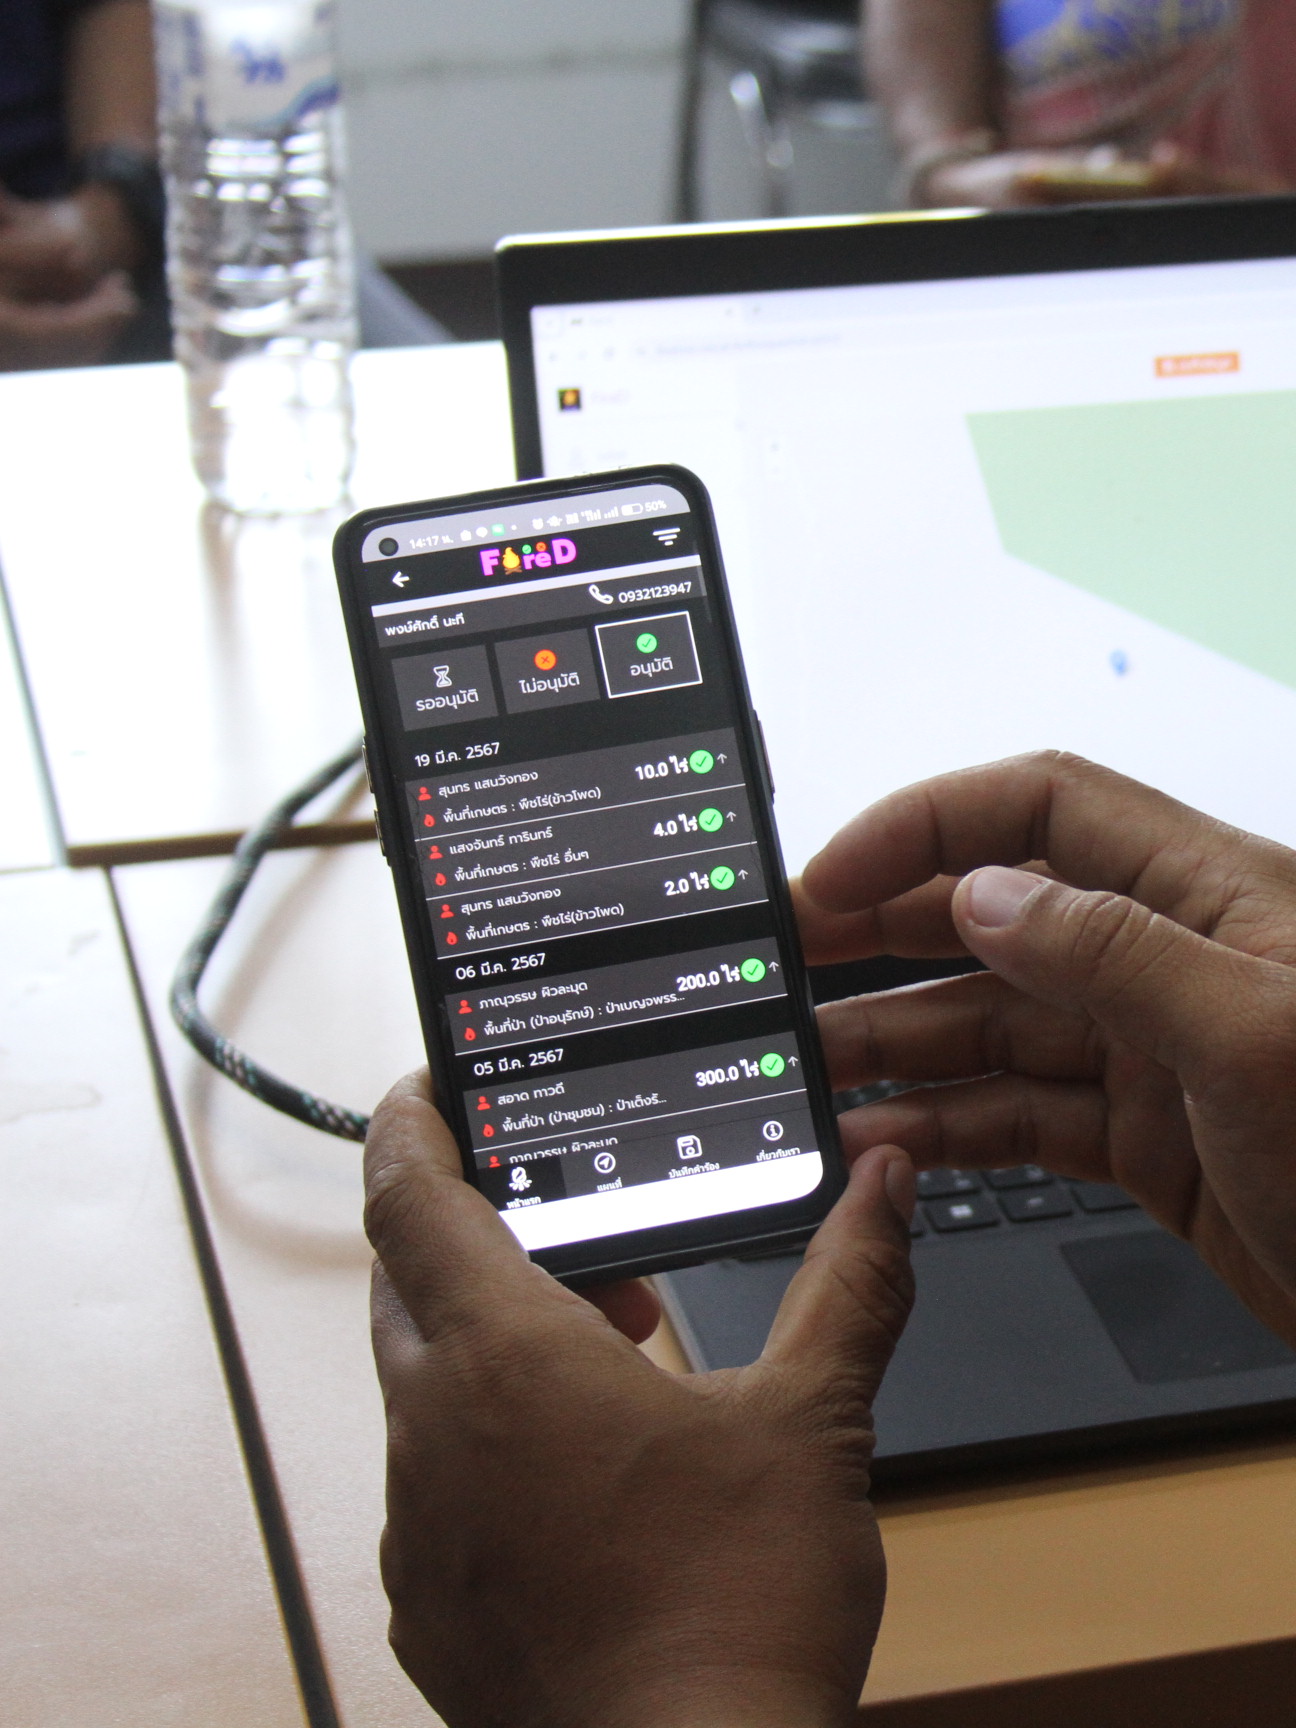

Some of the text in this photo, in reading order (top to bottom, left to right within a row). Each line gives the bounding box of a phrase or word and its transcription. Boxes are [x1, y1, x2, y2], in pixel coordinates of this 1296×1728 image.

[644, 500, 667, 512] 50%
[409, 535, 439, 549] 14:17
[618, 581, 692, 604] 0932123947
[385, 612, 466, 637] พงษ์ศักดิ์ นะที
[630, 656, 674, 678] อนุมัติ
[518, 672, 581, 695] ไม่อนุมัติ
[415, 688, 479, 712] รออนุมัติ
[414, 742, 500, 767] 19 มี.ค. 2567
[635, 755, 689, 780] 10.0 ไร่
[438, 771, 538, 798] สุนทร แสนวังทอง
[443, 803, 508, 823] พื้นที่เกษตร
[653, 813, 699, 837] 4.0 ไร่
[449, 835, 505, 855] แสงจันทร์
[454, 863, 519, 882] พื้นที่เกษตร
[530, 854, 561, 869] พืชไร่
[564, 848, 589, 863] อื่นๆ
[664, 871, 710, 896] 2.0 ไร่
[460, 887, 562, 916] สุนทร แสนวังทอง
[465, 921, 530, 941] พื้นที่เกษตร
[455, 952, 546, 980] 06 มี.ค. 2567
[676, 963, 740, 992] 200.0 ไร่
[483, 1017, 526, 1036] พื้นที่ป่า
[530, 1006, 595, 1030] (ป่าอนุรักษ์)
[473, 1048, 564, 1076] 05 มี.ค. 2567
[695, 1058, 760, 1087] 300.0 ไร่
[502, 1113, 545, 1133] พื้นที่ป่า
[548, 1103, 605, 1126] (ป่าชุมชน)
